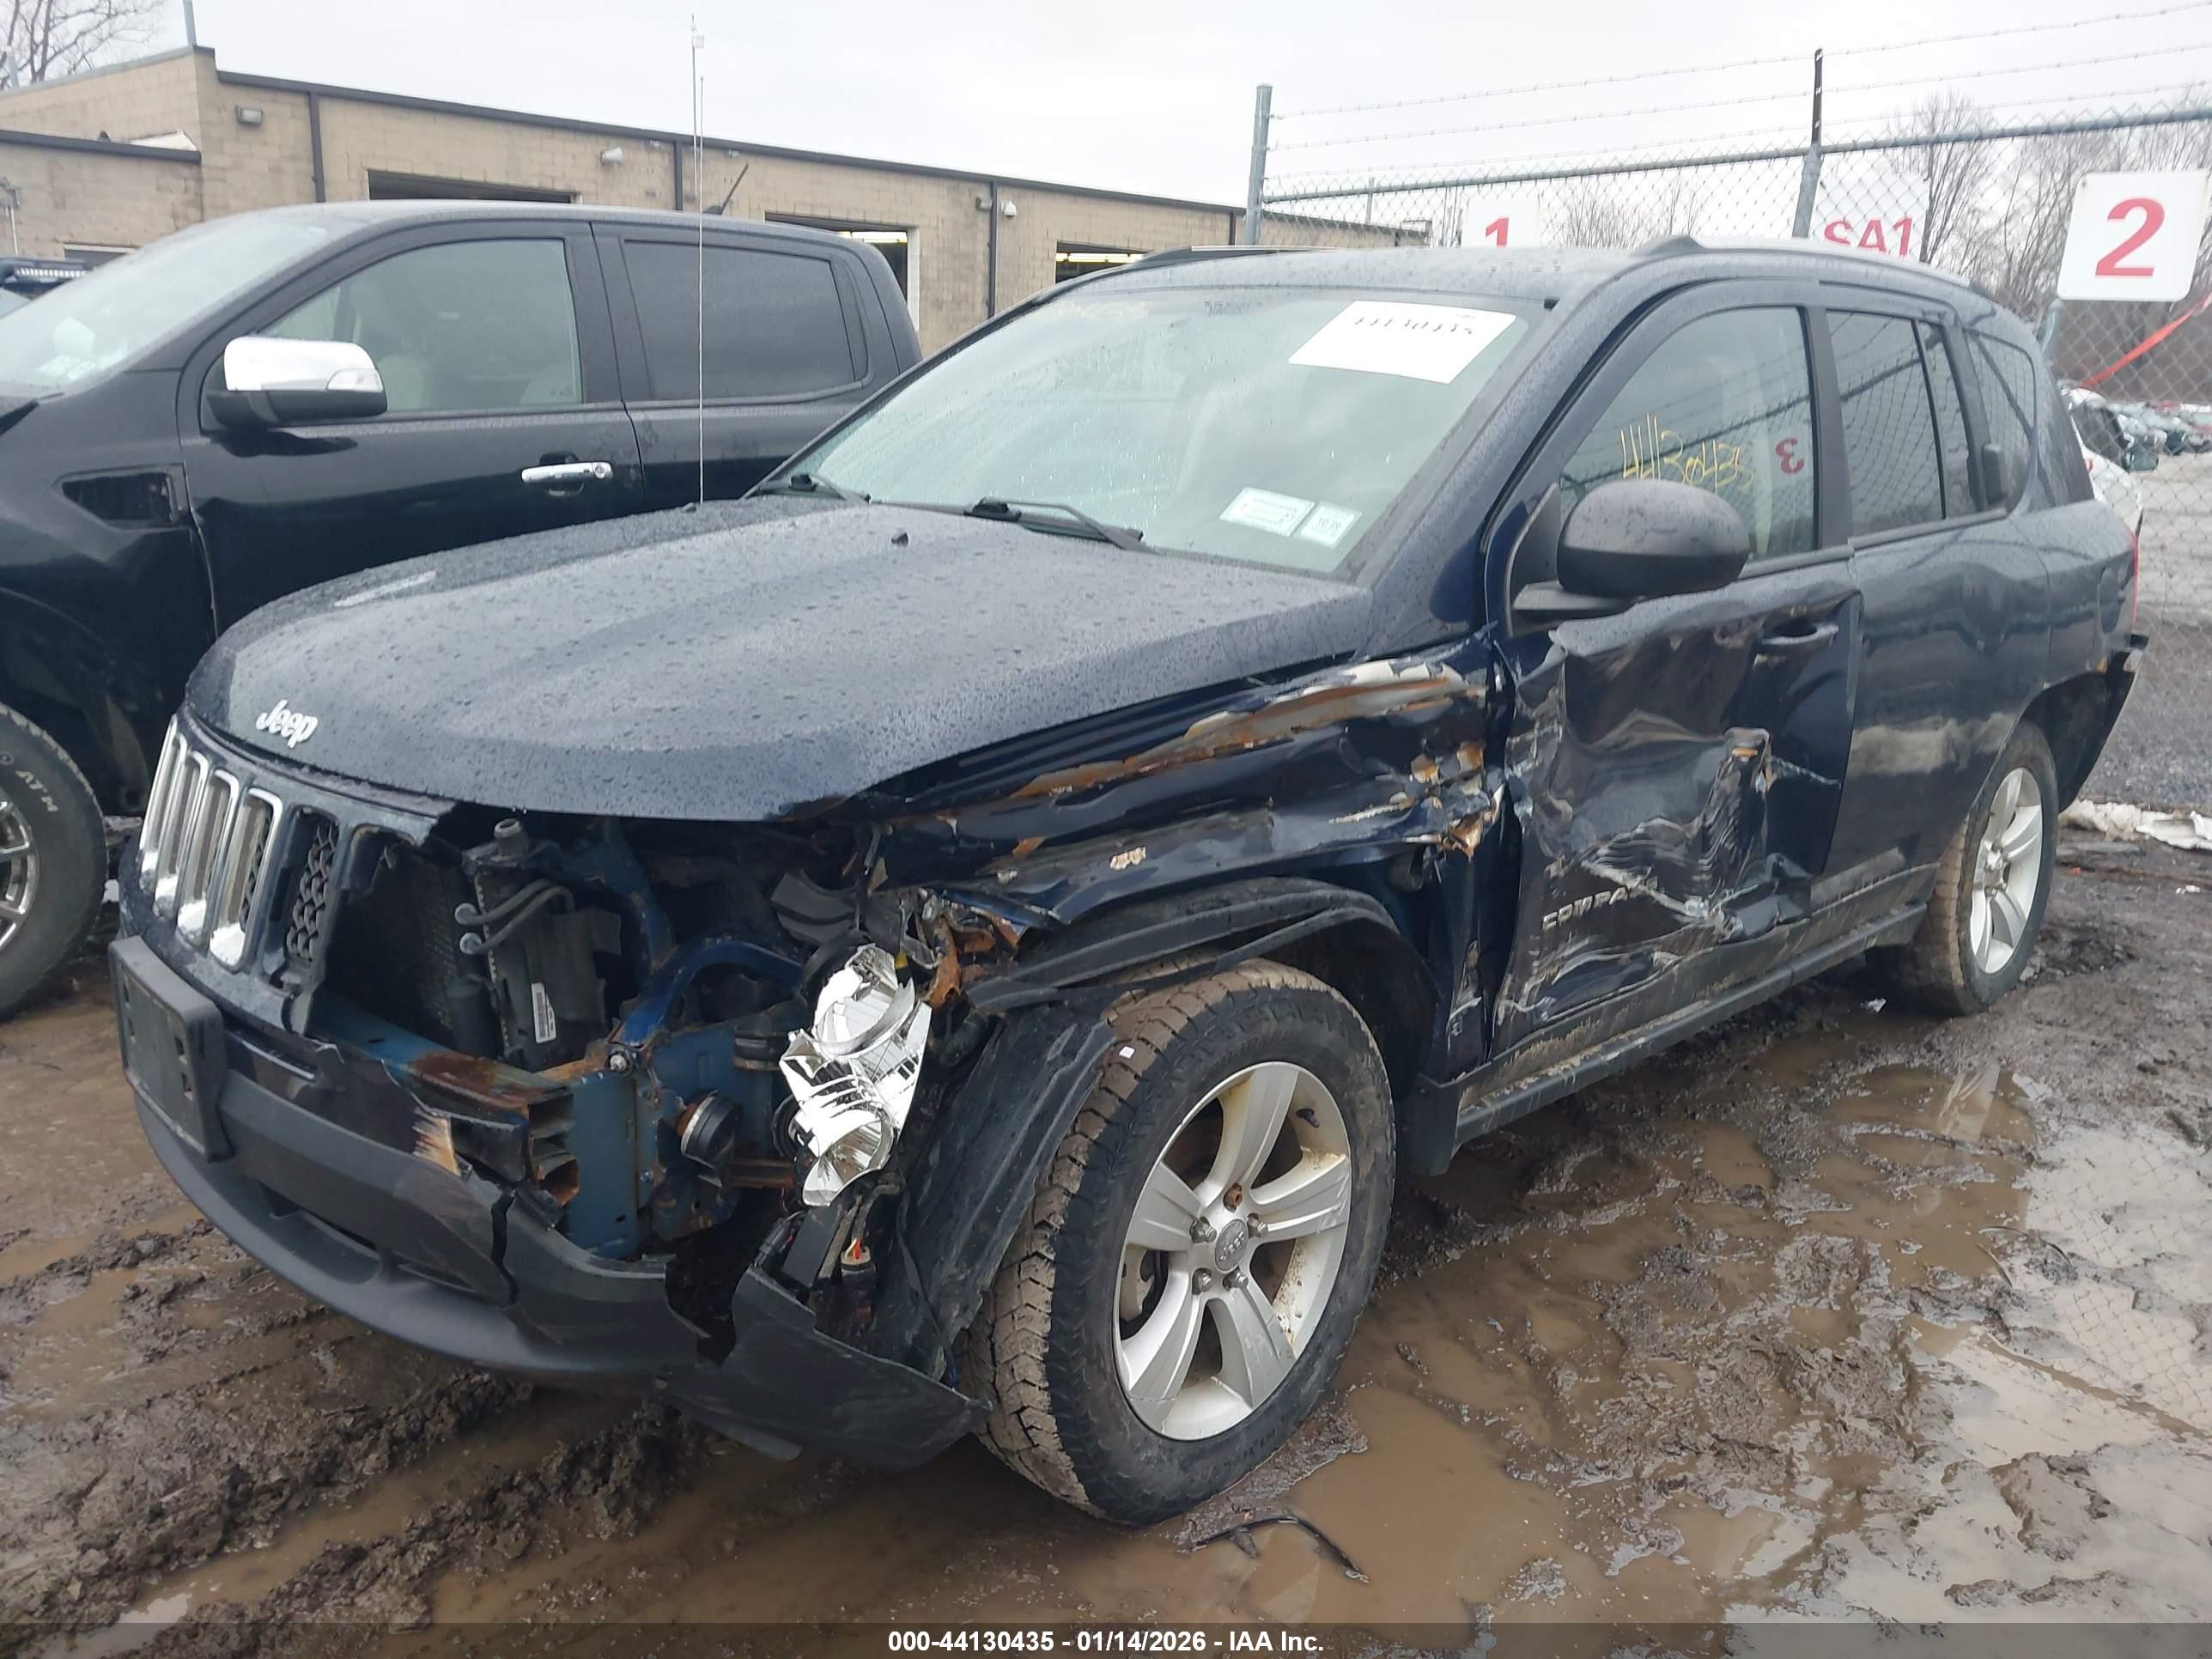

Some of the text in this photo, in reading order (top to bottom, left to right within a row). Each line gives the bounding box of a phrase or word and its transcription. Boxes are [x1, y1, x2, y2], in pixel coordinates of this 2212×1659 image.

[1823, 216, 1914, 256] SA1
[2094, 196, 2166, 276] 2
[255, 699, 319, 749] Jeep
